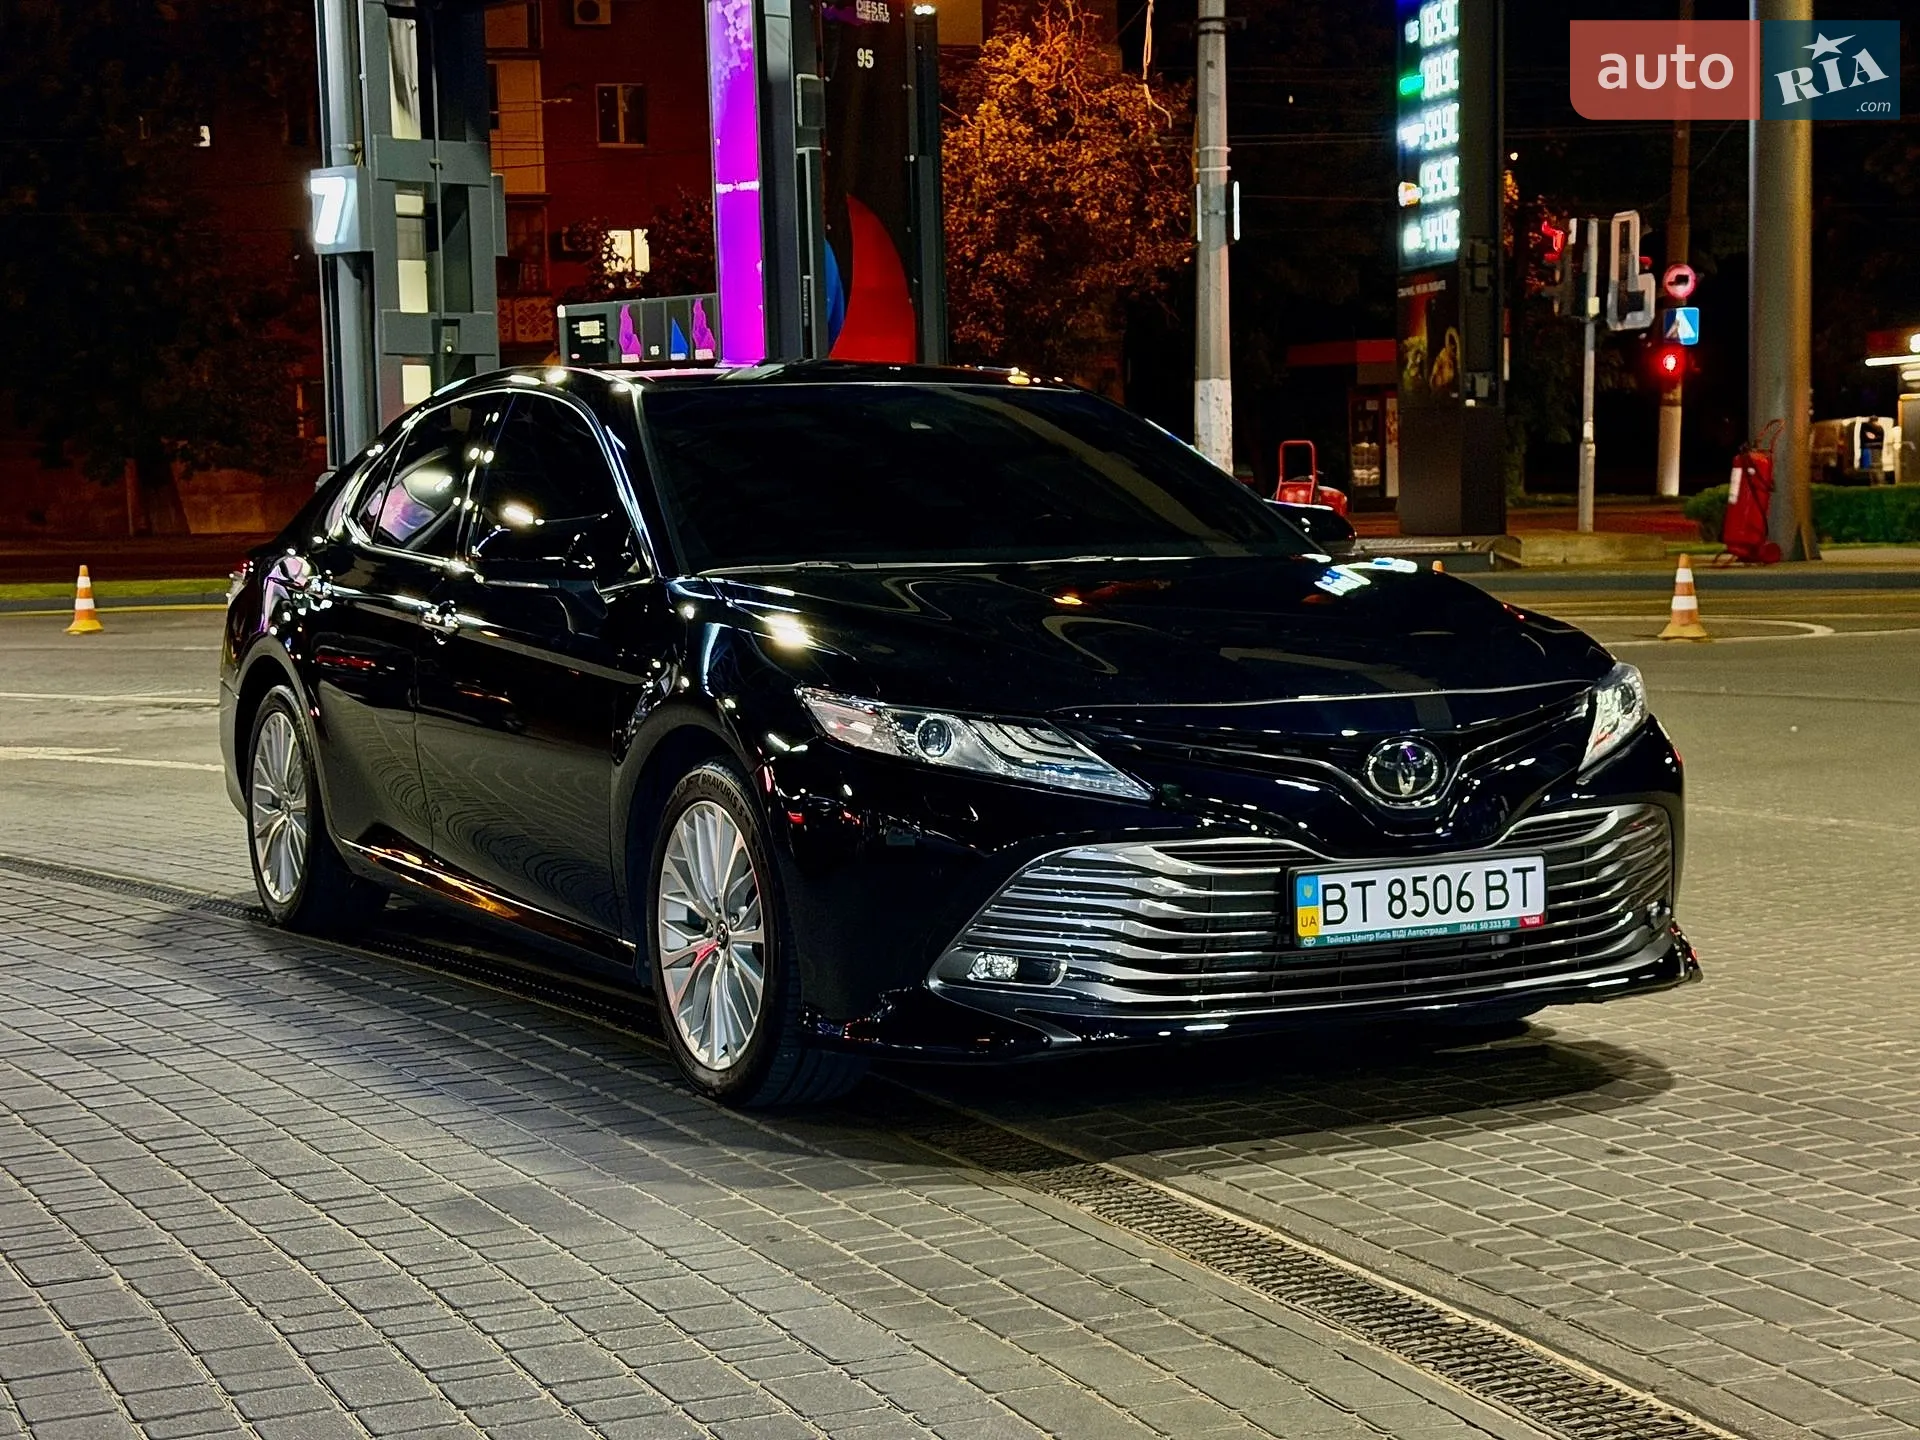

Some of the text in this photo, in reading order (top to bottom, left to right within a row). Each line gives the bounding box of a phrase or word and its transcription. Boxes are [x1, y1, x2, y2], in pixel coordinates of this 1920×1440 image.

[857, 48, 874, 68] 95
[311, 176, 346, 245] 7
[1322, 866, 1536, 926] BT 8506 BT
[1301, 916, 1317, 928] UA
